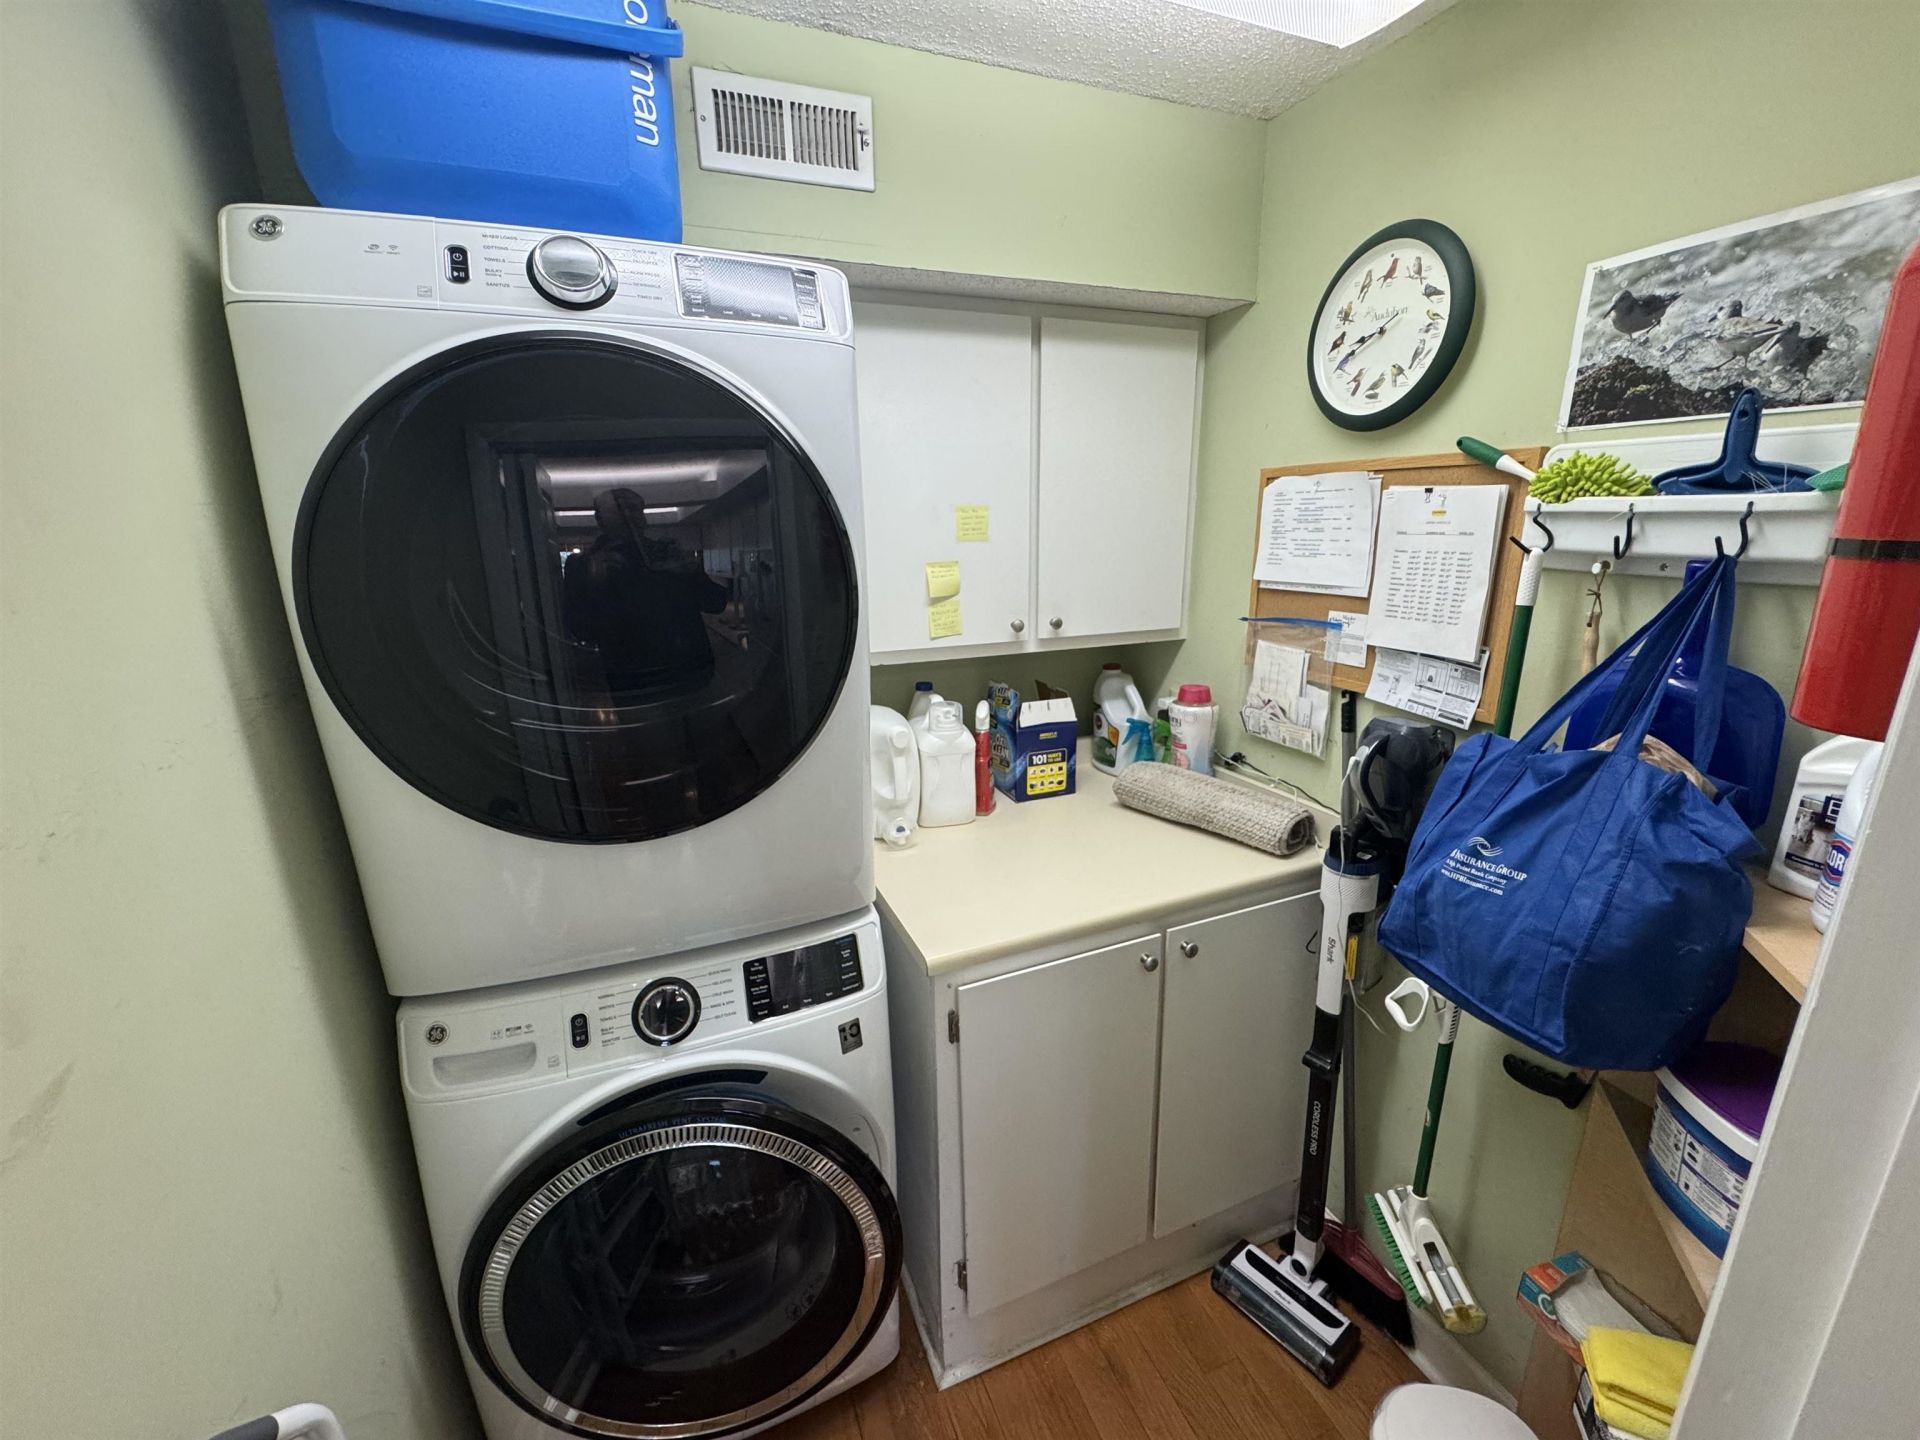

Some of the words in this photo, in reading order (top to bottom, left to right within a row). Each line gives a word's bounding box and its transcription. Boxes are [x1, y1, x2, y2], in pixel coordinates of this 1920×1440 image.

[1032, 754, 1047, 765] 101
[1327, 936, 1337, 965] Shark
[1313, 1100, 1321, 1139] CORDLESS
